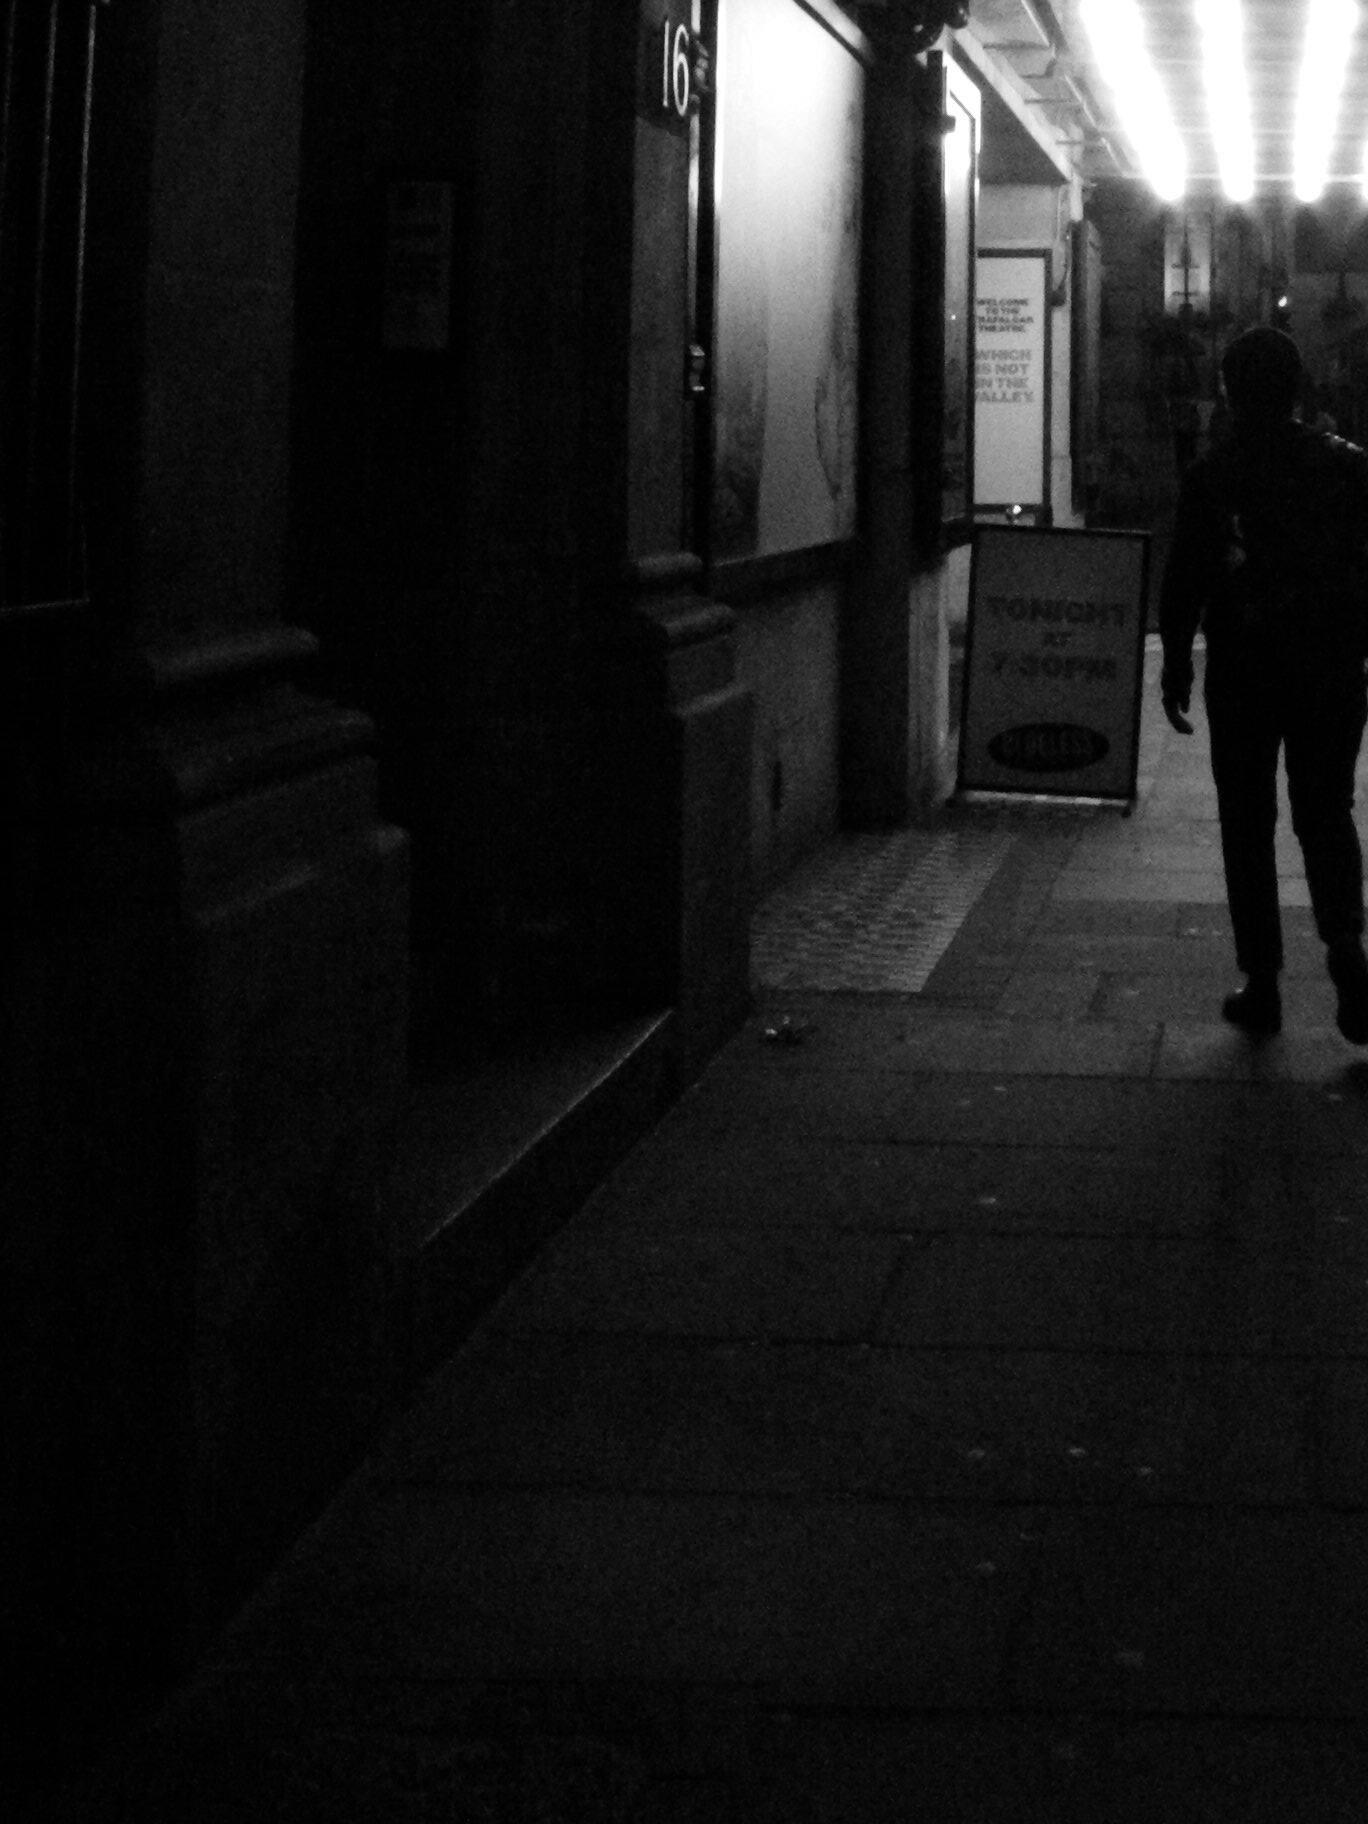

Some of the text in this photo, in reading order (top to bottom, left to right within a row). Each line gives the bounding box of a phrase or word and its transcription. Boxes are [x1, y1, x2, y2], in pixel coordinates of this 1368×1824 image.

[663, 20, 690, 117] 16
[985, 307, 1020, 315] TO THE
[995, 362, 1030, 375] NOT
[996, 377, 1030, 389] THE
[986, 596, 1125, 626] TONIGHT
